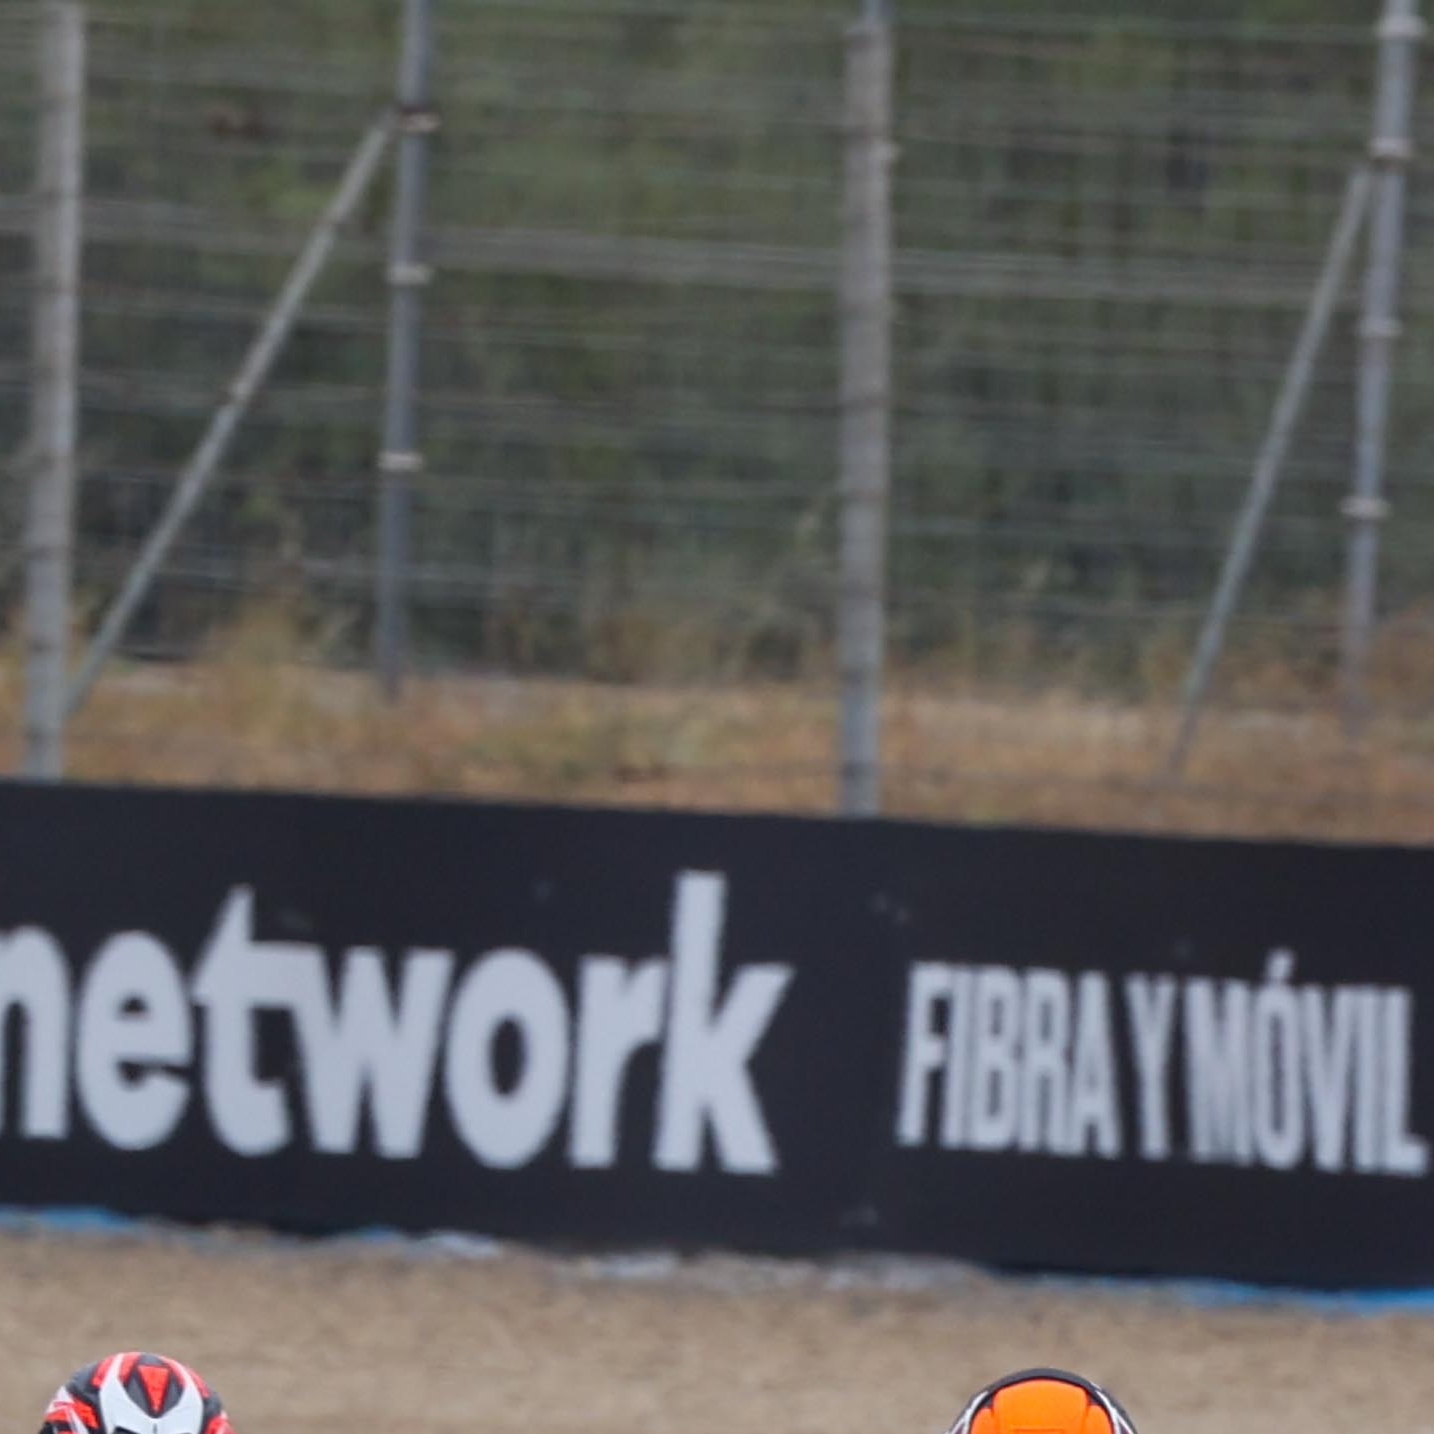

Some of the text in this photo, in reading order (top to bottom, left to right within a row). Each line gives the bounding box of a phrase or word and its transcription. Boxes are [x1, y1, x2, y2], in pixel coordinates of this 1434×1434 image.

[897, 949, 1429, 1177] FIBRA Y MÓVIL
